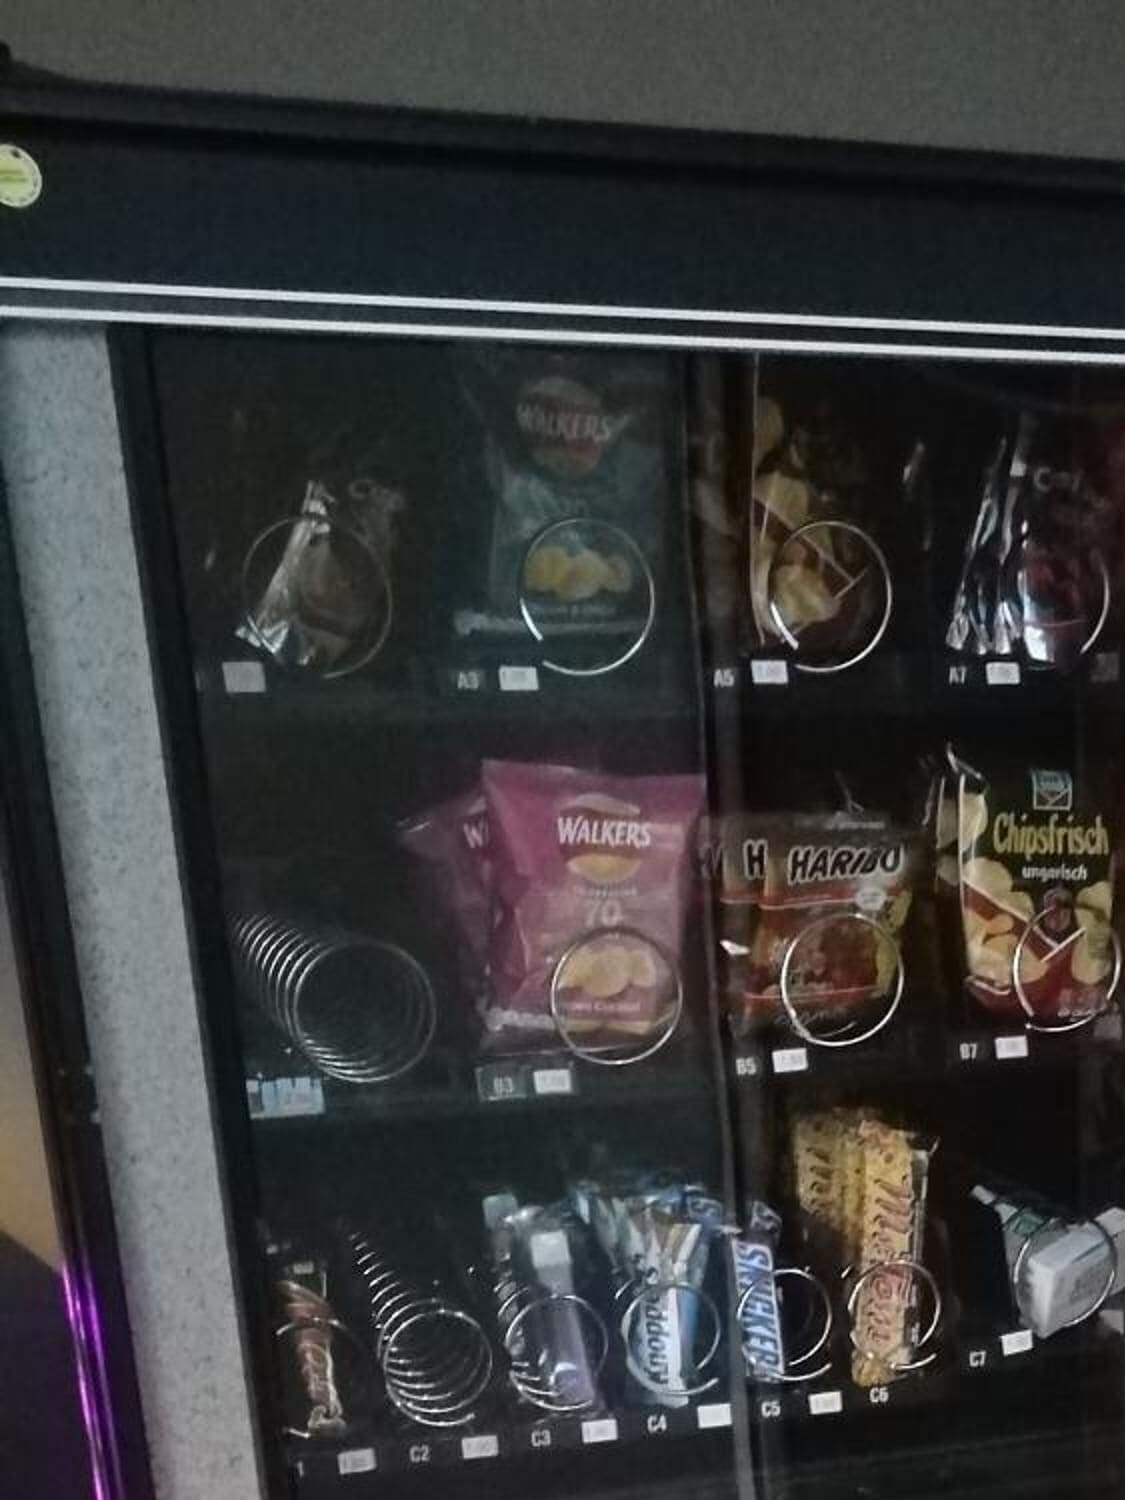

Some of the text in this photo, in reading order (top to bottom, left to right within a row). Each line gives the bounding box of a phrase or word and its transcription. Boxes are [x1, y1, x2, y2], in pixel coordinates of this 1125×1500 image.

[714, 668, 735, 687] A5
[949, 665, 968, 684] A7
[557, 815, 652, 850] WALKERS
[993, 811, 1109, 862] Chipsfrisch
[788, 843, 905, 890] HARIBO
[1021, 863, 1088, 882] ungarisch
[969, 1351, 986, 1367] C7
[761, 1400, 781, 1418] C5
[647, 1414, 667, 1434] C4
[531, 1428, 551, 1447] C3
[409, 1444, 430, 1463] C2
